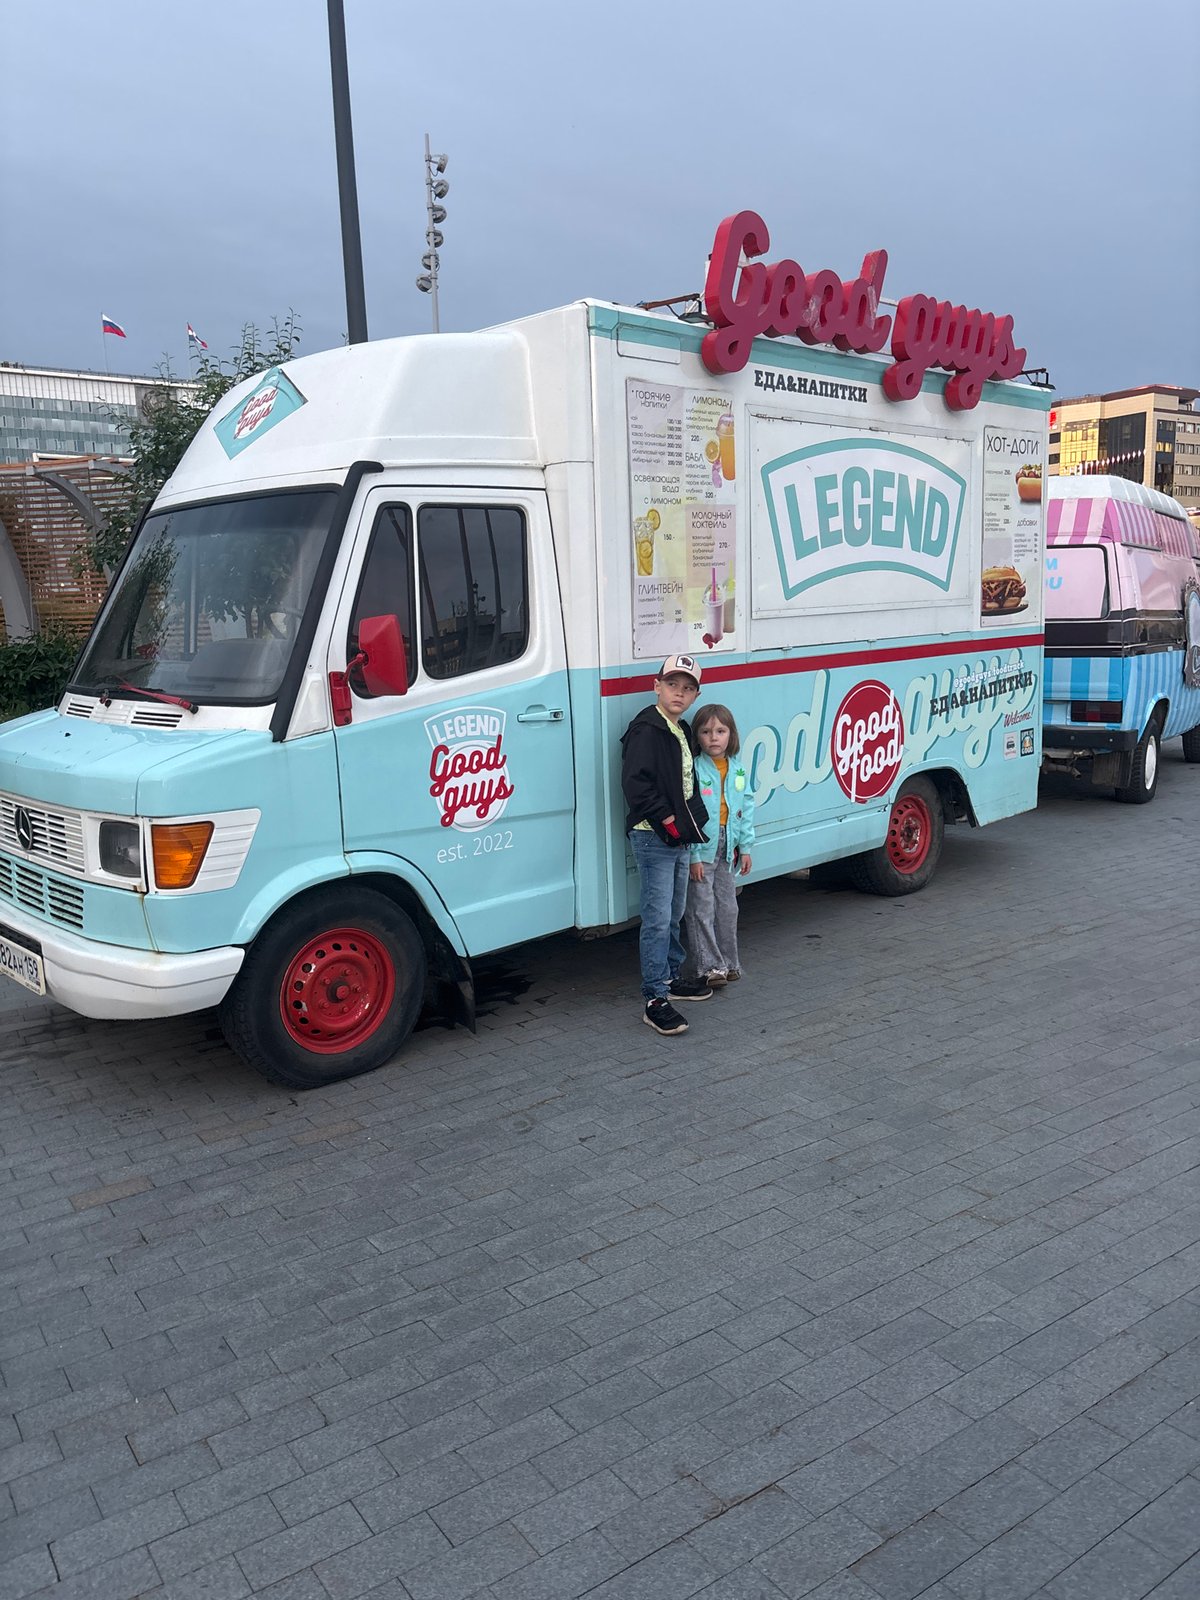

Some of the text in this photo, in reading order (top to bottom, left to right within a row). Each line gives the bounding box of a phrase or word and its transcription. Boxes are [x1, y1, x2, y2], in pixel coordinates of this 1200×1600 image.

[702, 210, 1027, 411] Good guys
[754, 370, 868, 403] ЕДА&НАПИТКИ
[784, 466, 949, 561] LEGEND
[929, 671, 1033, 717] ЕДА&НАПИТКИ
[432, 714, 501, 744] LEGEND
[836, 690, 900, 775] Good
[429, 734, 507, 797] Good
[850, 720, 904, 803] food
[441, 775, 515, 827] guys
[437, 831, 514, 864] est. 2022
